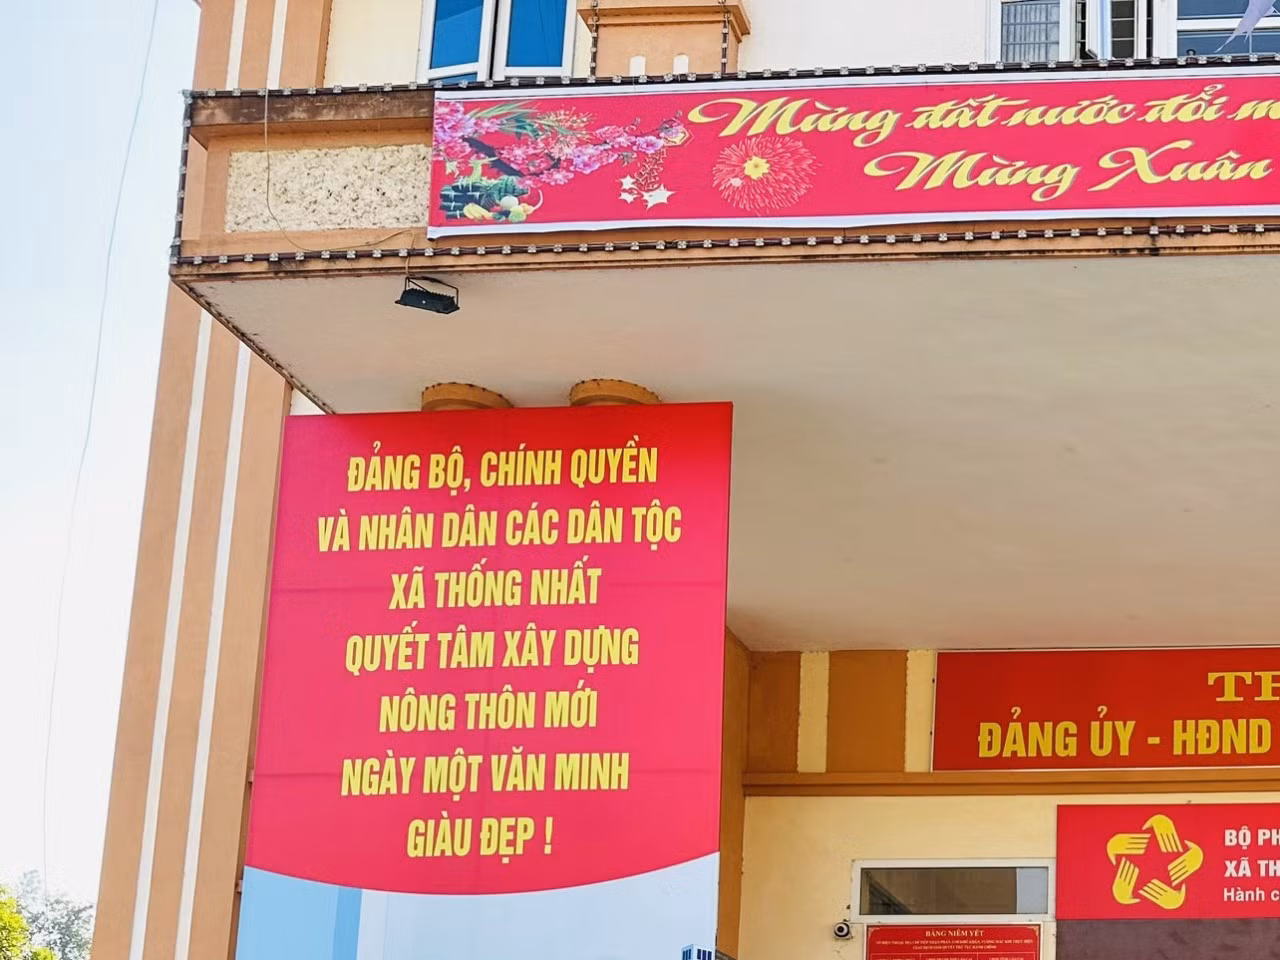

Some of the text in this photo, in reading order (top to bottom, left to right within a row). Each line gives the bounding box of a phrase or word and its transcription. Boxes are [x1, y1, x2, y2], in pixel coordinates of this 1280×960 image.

[688, 97, 903, 147] Mừng
[905, 94, 1028, 130] đất
[1001, 95, 1135, 127] nước
[1143, 83, 1229, 124] đổi
[863, 150, 1081, 202] Mừng
[1088, 139, 1272, 192] Xuân
[348, 435, 657, 496] ĐẢNG BỘ, CHÍNH QUYỀN
[318, 500, 681, 552] VÀ NHÂN DÂN CÁC DÂN TỘC
[389, 555, 602, 609] XÃ THỐNG NHẤT
[345, 621, 639, 676] QUYẾT TÂM XÂY DỰNG
[379, 679, 597, 732] NÔNG THÔN MỚI
[978, 706, 1077, 758] ĐẢNG
[1090, 706, 1136, 757] ỦY
[1173, 718, 1271, 755] HĐND
[340, 746, 629, 801] NGÀY MỘT VĂN MINH
[407, 811, 471, 858] GIÀU
[480, 816, 534, 863] ĐẸP
[1225, 826, 1251, 849] BỘ
[1224, 857, 1251, 877] XÃ
[1224, 887, 1264, 902] Hành
